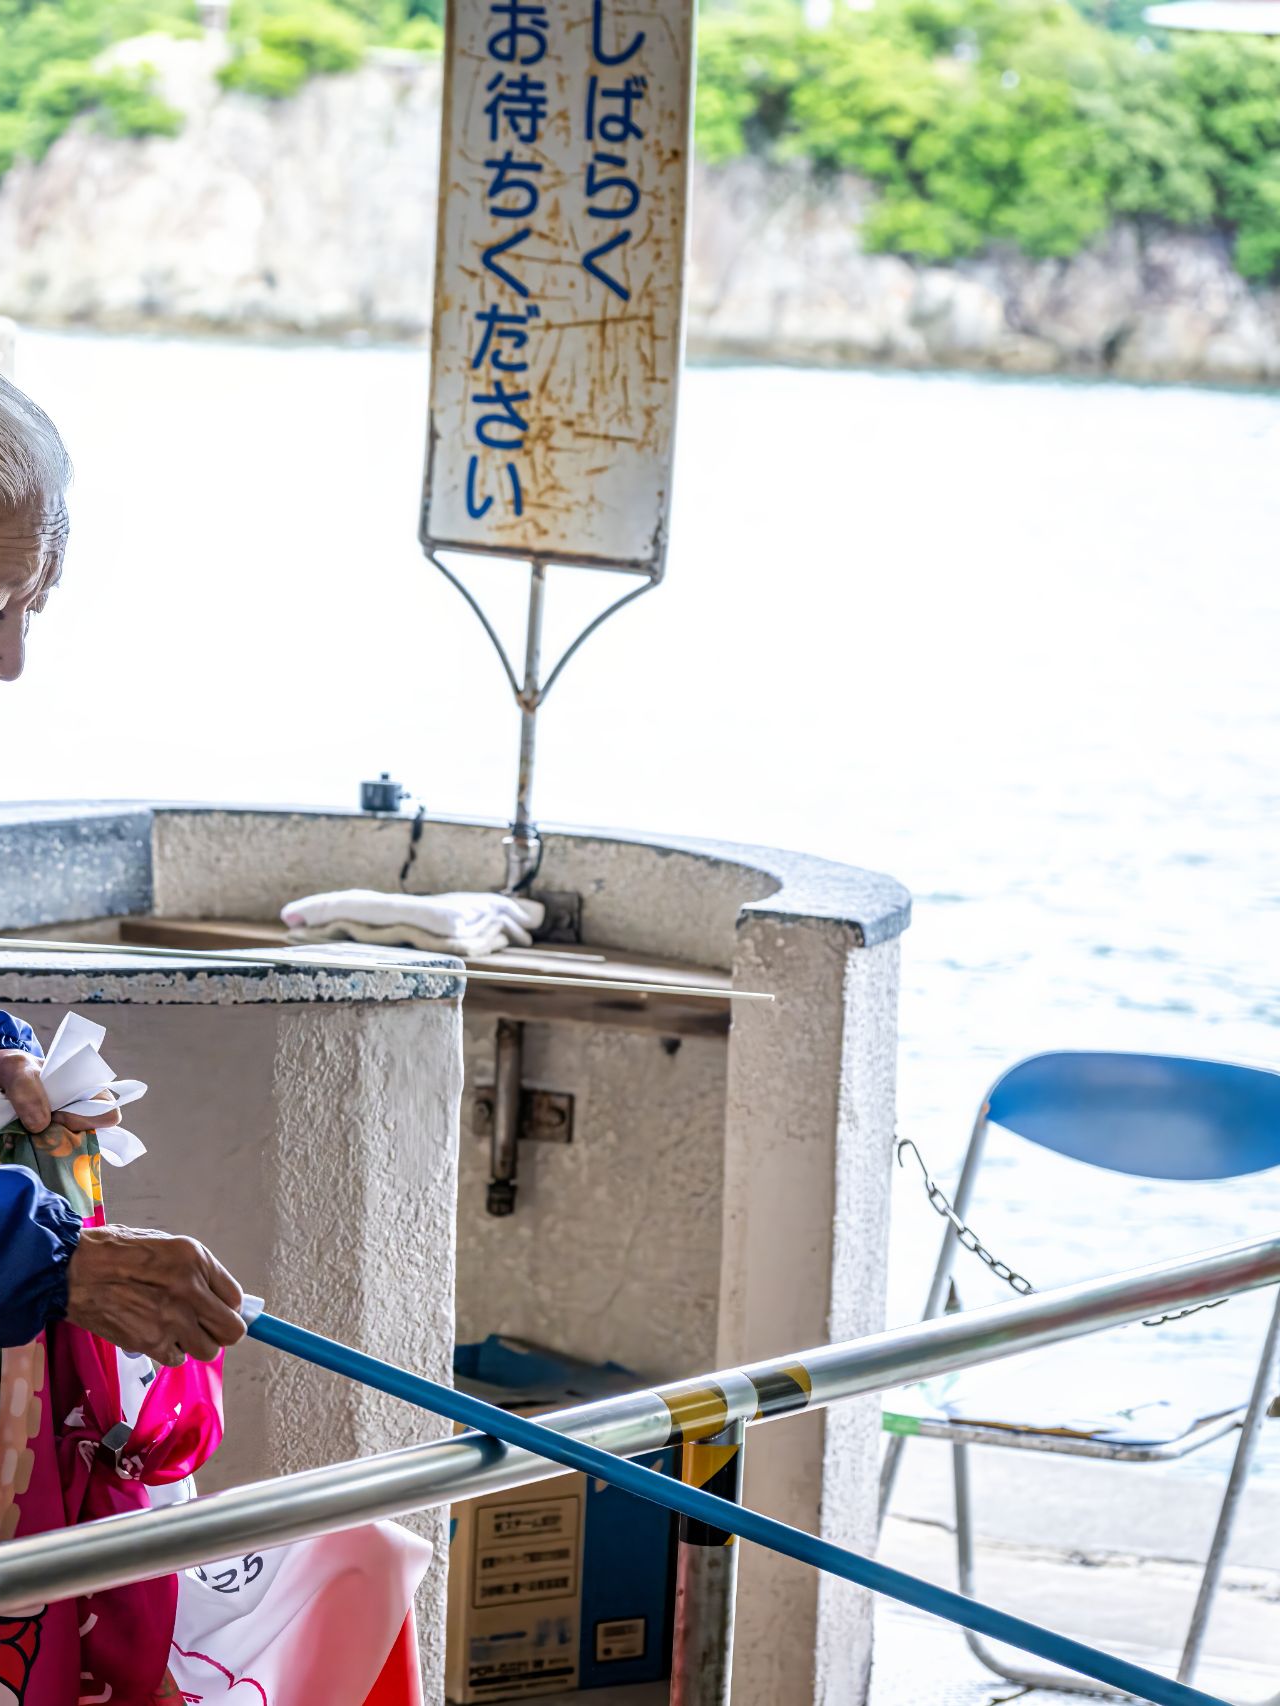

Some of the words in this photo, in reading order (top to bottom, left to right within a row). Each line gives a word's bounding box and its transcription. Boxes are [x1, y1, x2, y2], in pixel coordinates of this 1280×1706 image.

[466, 0, 549, 518] お待ちください
[582, 0, 648, 301] しばらく
